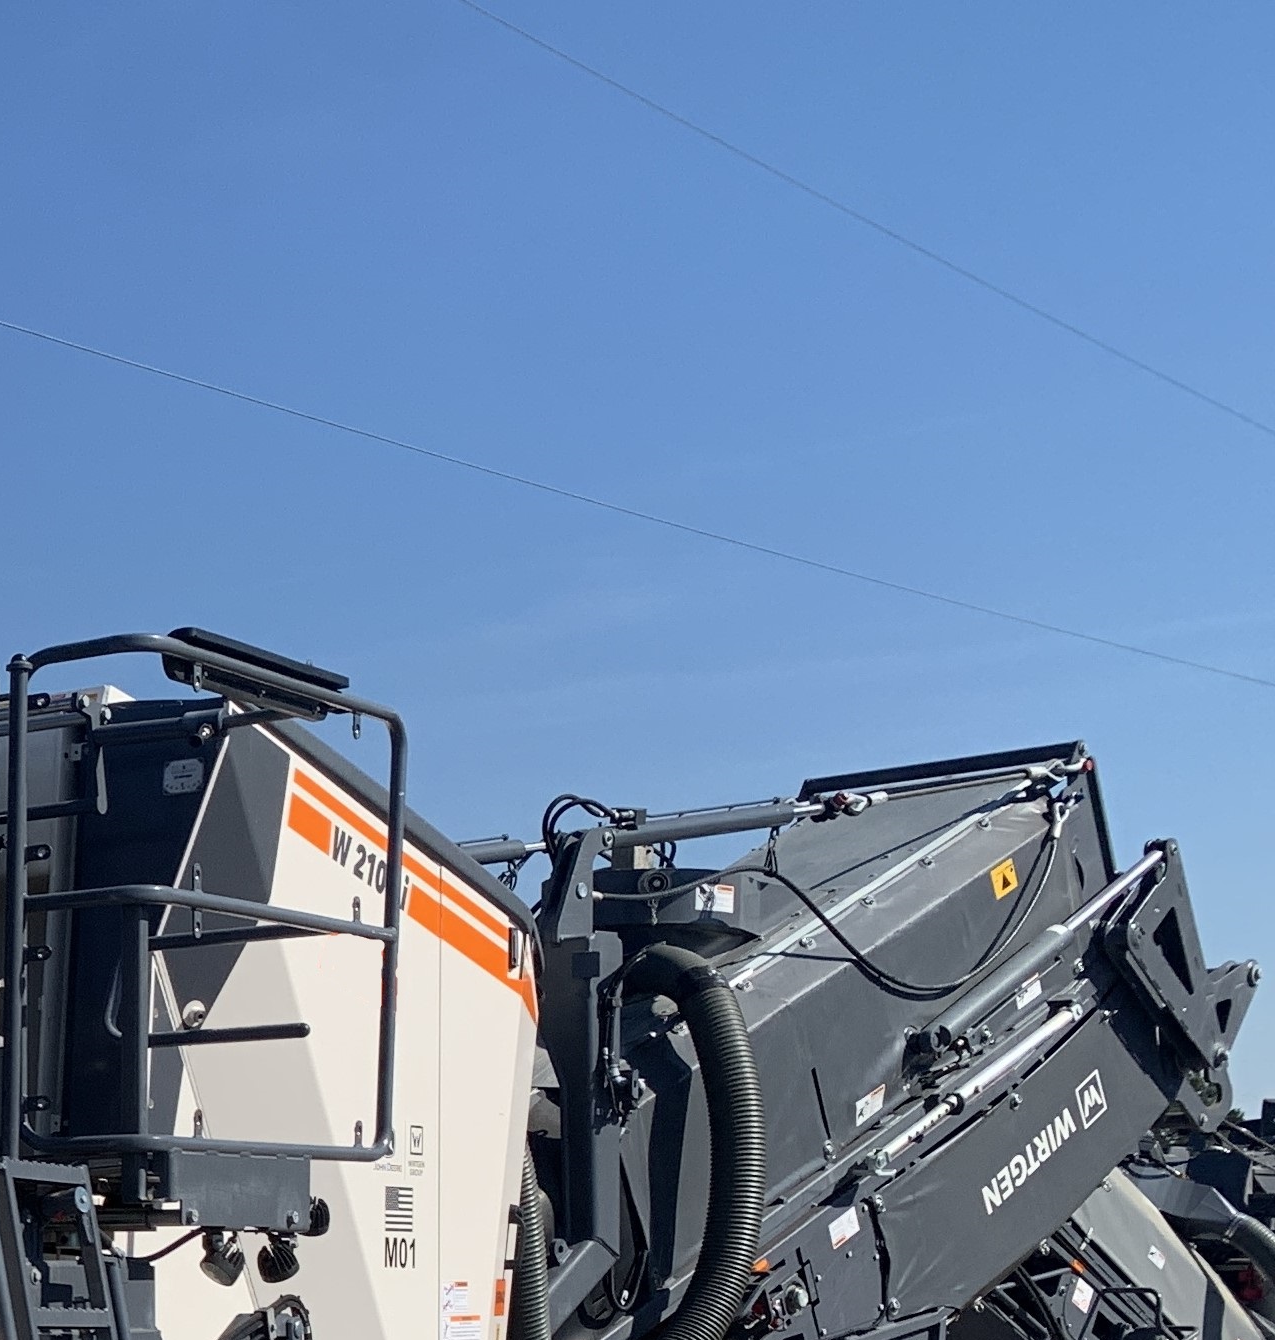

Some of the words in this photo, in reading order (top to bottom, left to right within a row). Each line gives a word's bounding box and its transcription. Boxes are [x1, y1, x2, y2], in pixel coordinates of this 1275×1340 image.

[332, 825, 352, 868] W
[353, 844, 387, 894] 210
[981, 1107, 1077, 1215] WIRTGEN
[384, 1236, 416, 1269] M01
